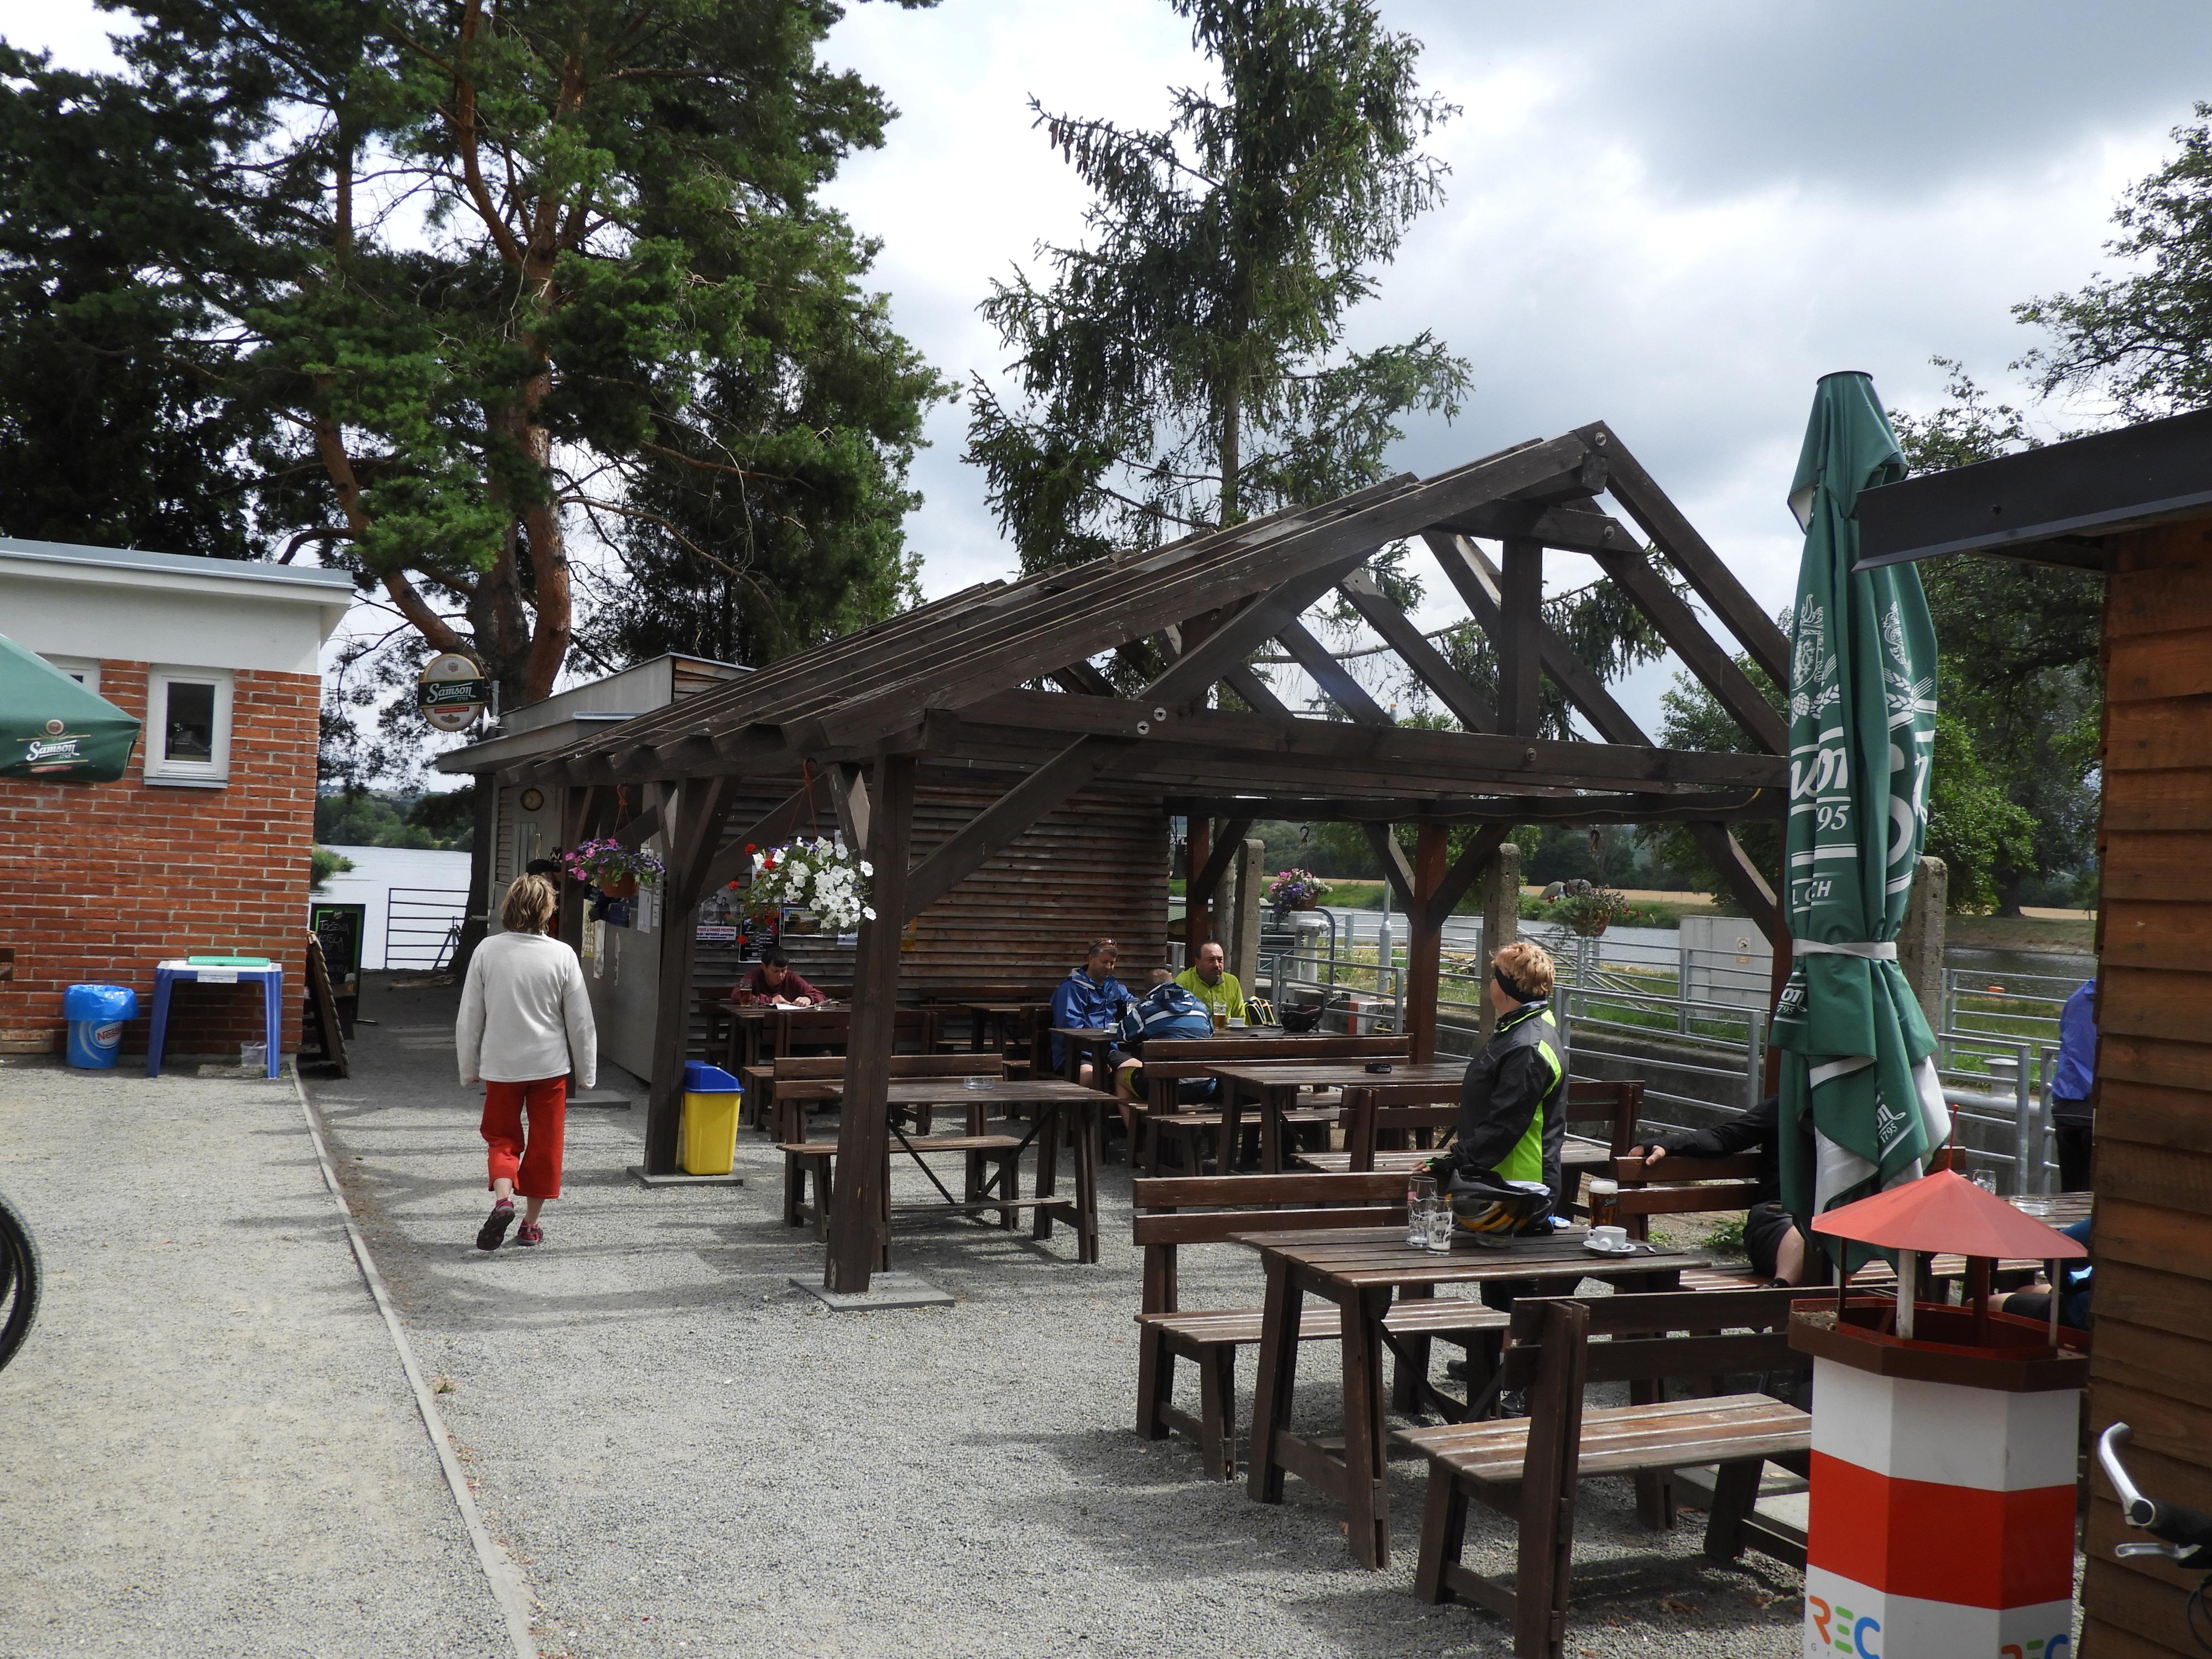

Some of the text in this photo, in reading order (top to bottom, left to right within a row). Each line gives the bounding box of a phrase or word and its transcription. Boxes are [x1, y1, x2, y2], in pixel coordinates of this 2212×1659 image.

[426, 682, 476, 703] Samson
[26, 740, 80, 761] Samson
[1880, 1122, 1897, 1143] 1795
